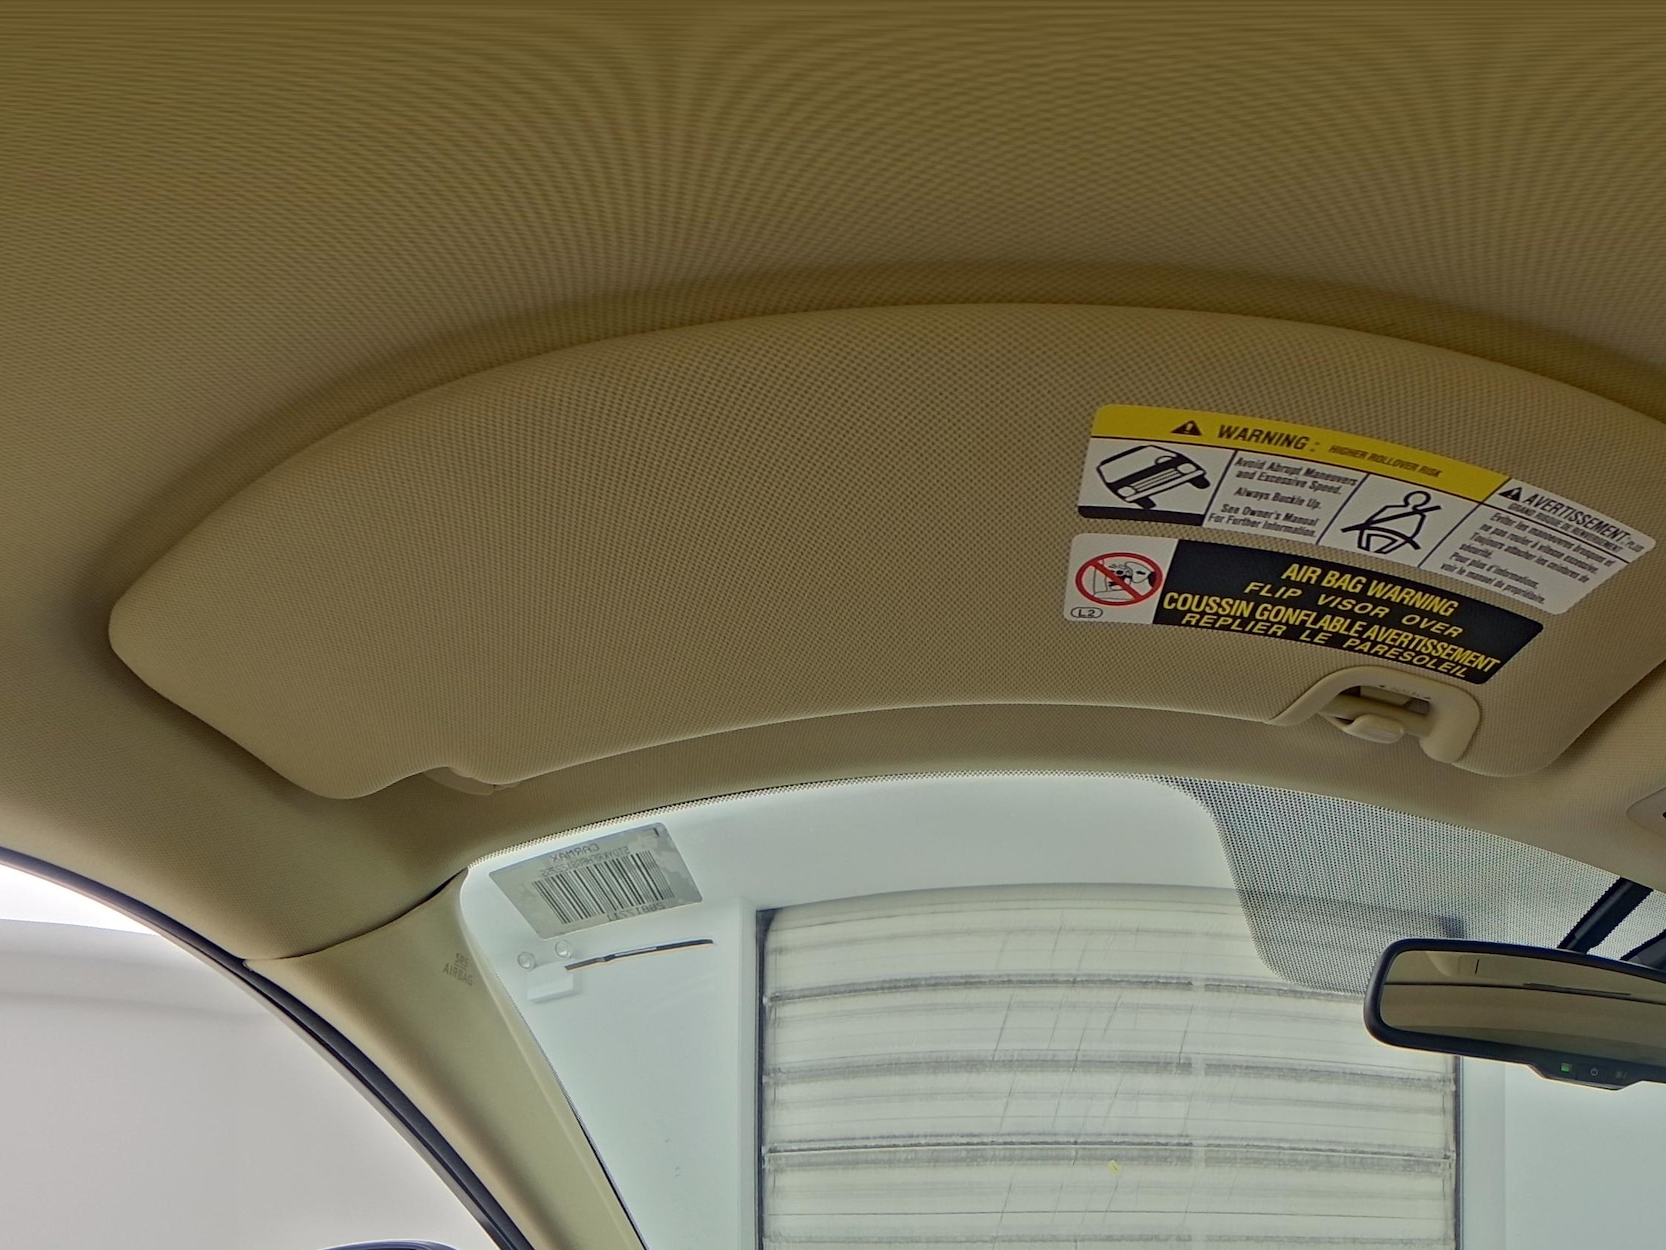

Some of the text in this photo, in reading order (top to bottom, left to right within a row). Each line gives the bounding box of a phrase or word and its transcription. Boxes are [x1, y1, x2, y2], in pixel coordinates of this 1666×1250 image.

[1217, 425, 1442, 477] WARNING HIGHER ROLLOVER RISK
[1235, 457, 1358, 486] Avoid Abrupt Maneuvers
[1236, 471, 1341, 495] and Excessive Speed.
[1234, 487, 1321, 510] Always Buckle Up.
[1509, 503, 1535, 516] GRAND
[1208, 513, 1316, 537] For Further Information.
[1221, 503, 1319, 527] See Owner's Manual
[1281, 564, 1459, 617] AIR BAG WARNING
[1076, 608, 1096, 617] L2
[1244, 582, 1463, 638] FLIP VISOR OVER
[1163, 592, 1500, 672] COUSSIN GONFLABLE AVERTISSEMENT
[1181, 613, 1467, 678] REPLIER LE PARESOLEIL
[454, 953, 469, 968] SRS
[443, 964, 474, 986] AIRBAG
